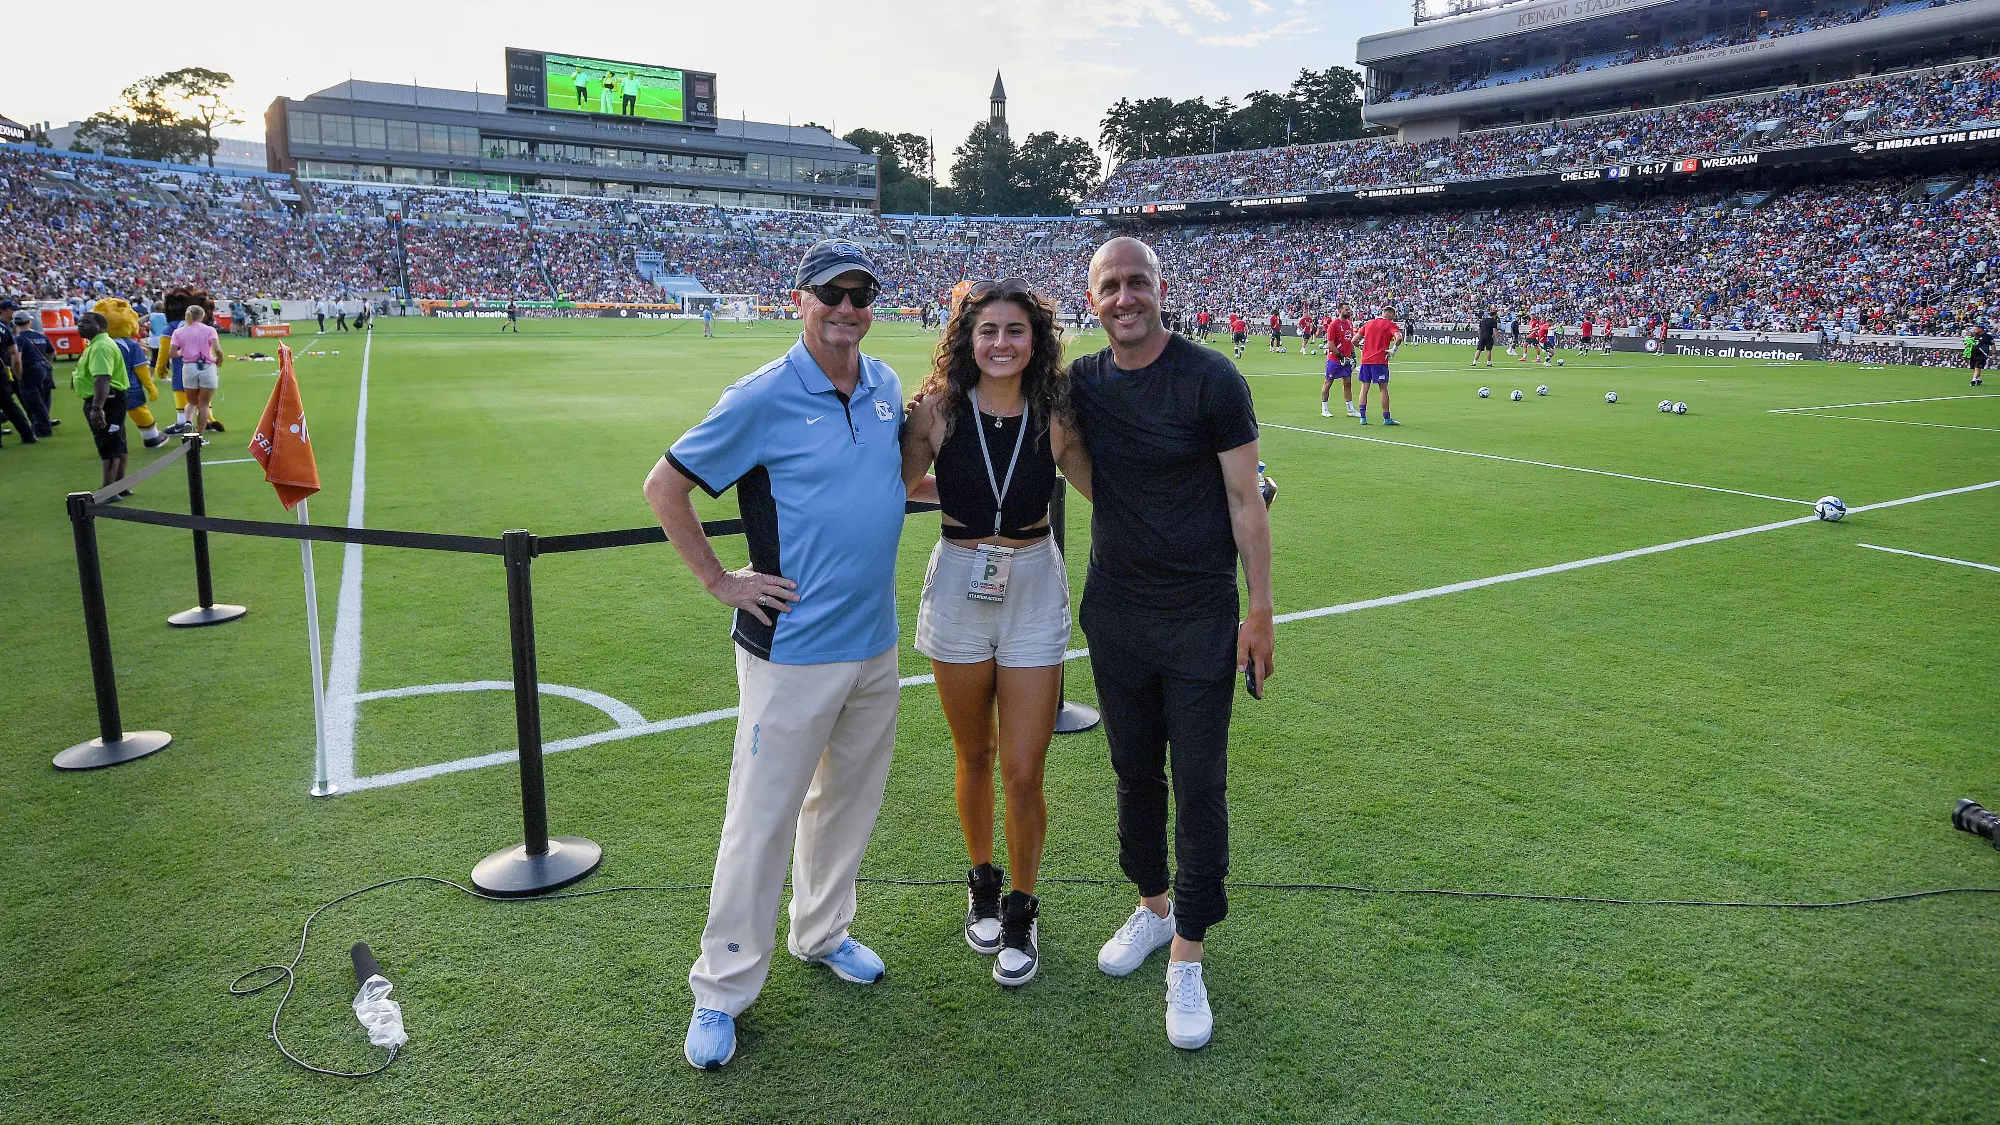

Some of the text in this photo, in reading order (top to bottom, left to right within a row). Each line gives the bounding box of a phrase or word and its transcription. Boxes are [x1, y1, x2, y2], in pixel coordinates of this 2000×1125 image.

[1517, 0, 1636, 27] KENAN STAD
[1663, 58, 1677, 67] JOY
[1686, 54, 1705, 63] JOHN
[1708, 50, 1727, 59] POPE
[1730, 44, 1757, 55] FAMILY
[1759, 41, 1776, 50] BOX
[511, 63, 540, 72] NISSAN
[514, 83, 536, 93] UNC
[1876, 135, 1938, 151] EMBRACE
[1940, 132, 1967, 144] THE
[1560, 154, 1759, 182] CHELSEA 0 14:17 0 WREXHAM
[1368, 189, 1400, 198] EMBRACE
[1401, 187, 1415, 195] THE
[1241, 198, 1270, 207] EMBRACE
[1270, 197, 1282, 205] THE
[1122, 206, 1140, 214] 14:17
[1156, 204, 1187, 212] WREXHAM
[436, 310, 454, 318] This
[464, 310, 475, 318] all
[476, 310, 508, 318] togethe
[637, 311, 652, 319] This
[56, 337, 70, 349] G
[1413, 334, 1479, 346] This is all togeth
[1675, 344, 1804, 361] This is all together.
[983, 564, 998, 581] P
